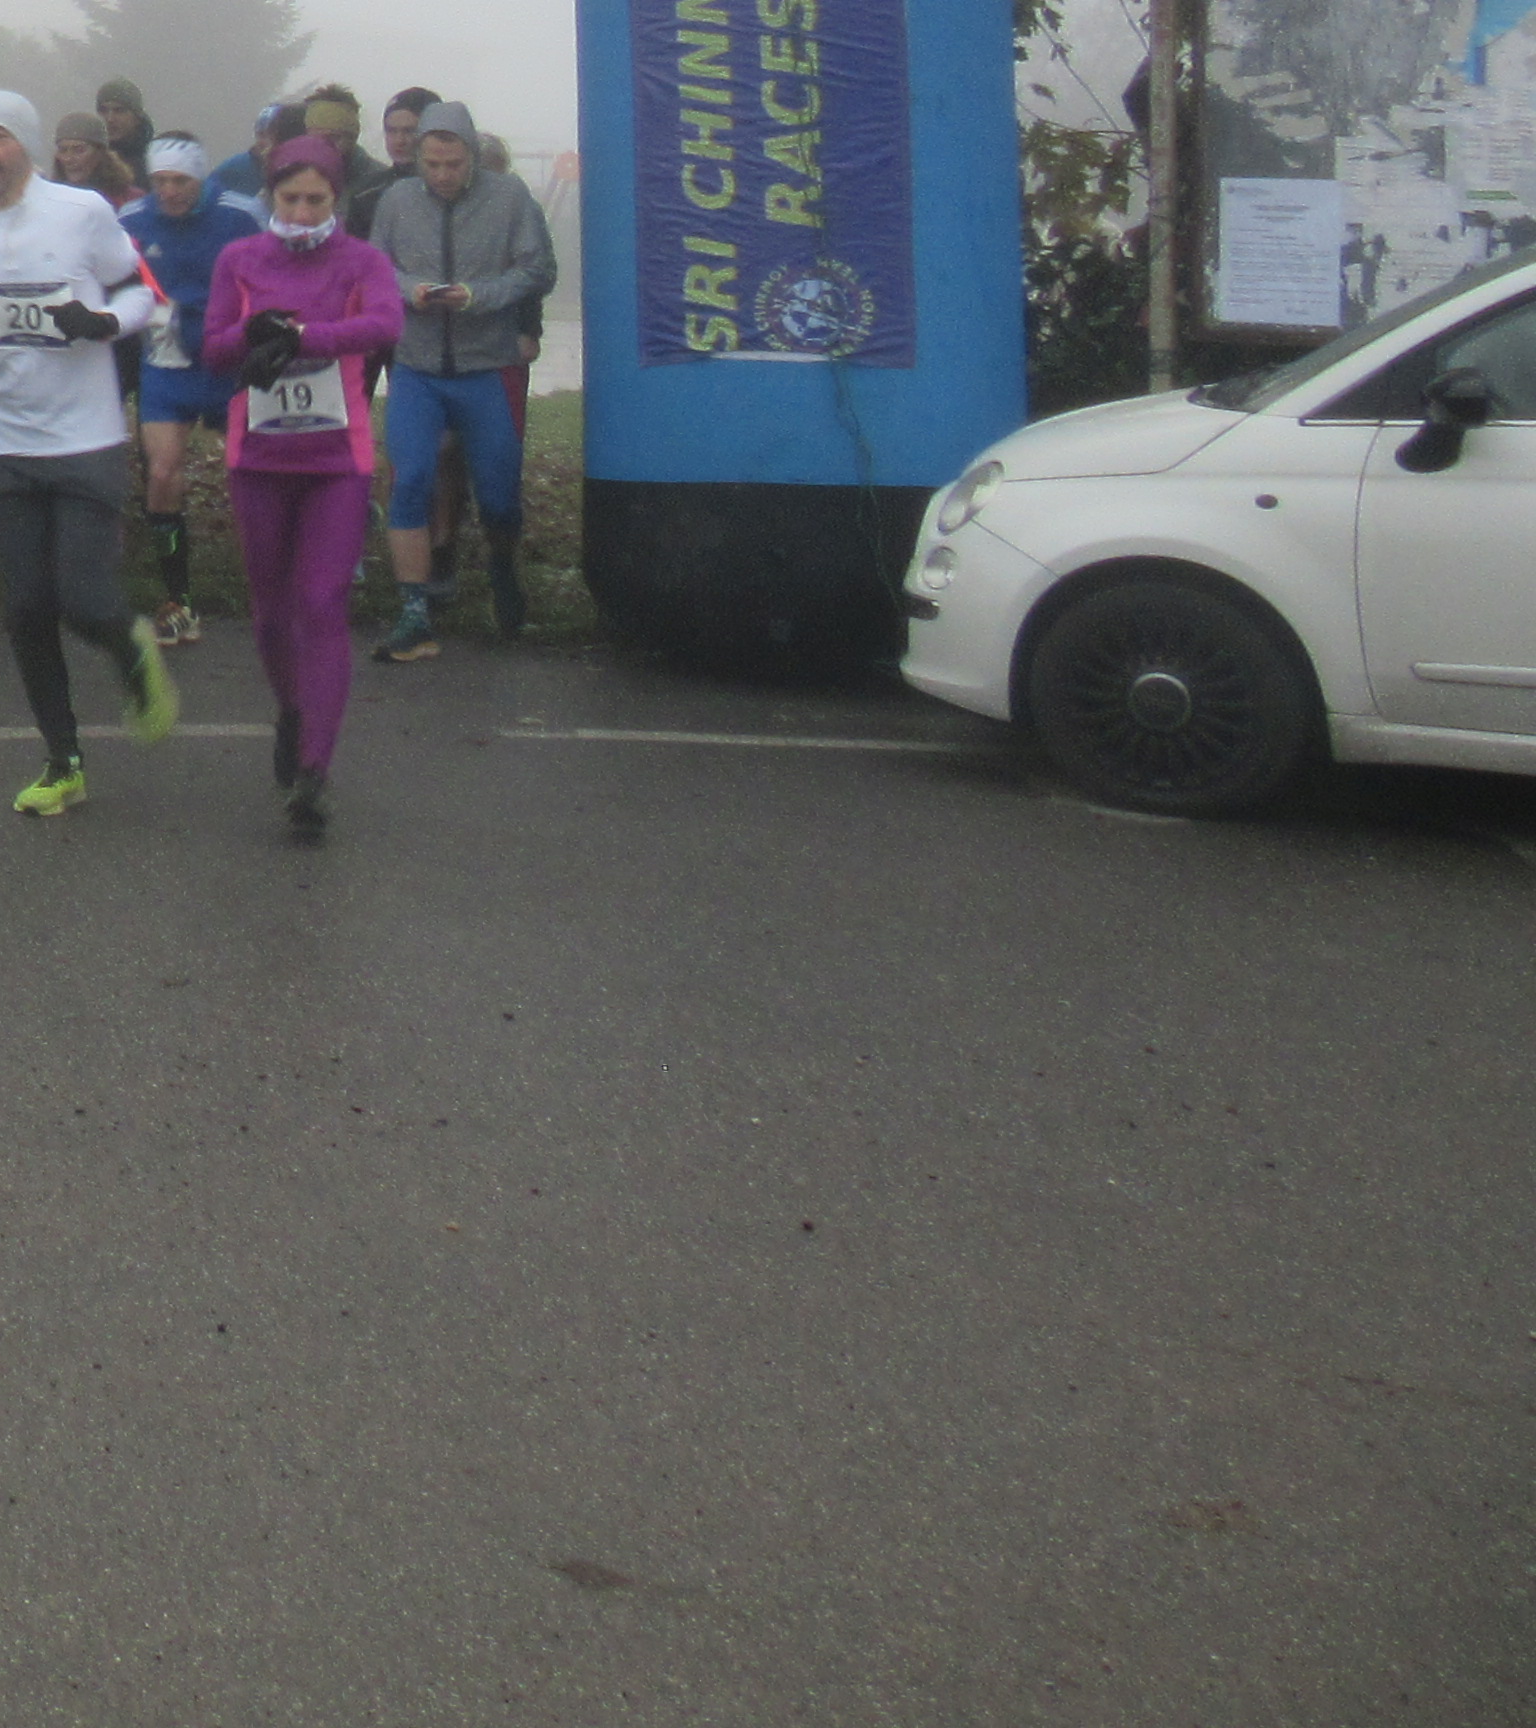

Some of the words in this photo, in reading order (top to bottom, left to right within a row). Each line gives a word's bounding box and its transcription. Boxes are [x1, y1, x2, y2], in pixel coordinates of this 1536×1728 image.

[682, 235, 739, 354] SRI
[4, 303, 42, 330] 20
[274, 382, 313, 411] 19
